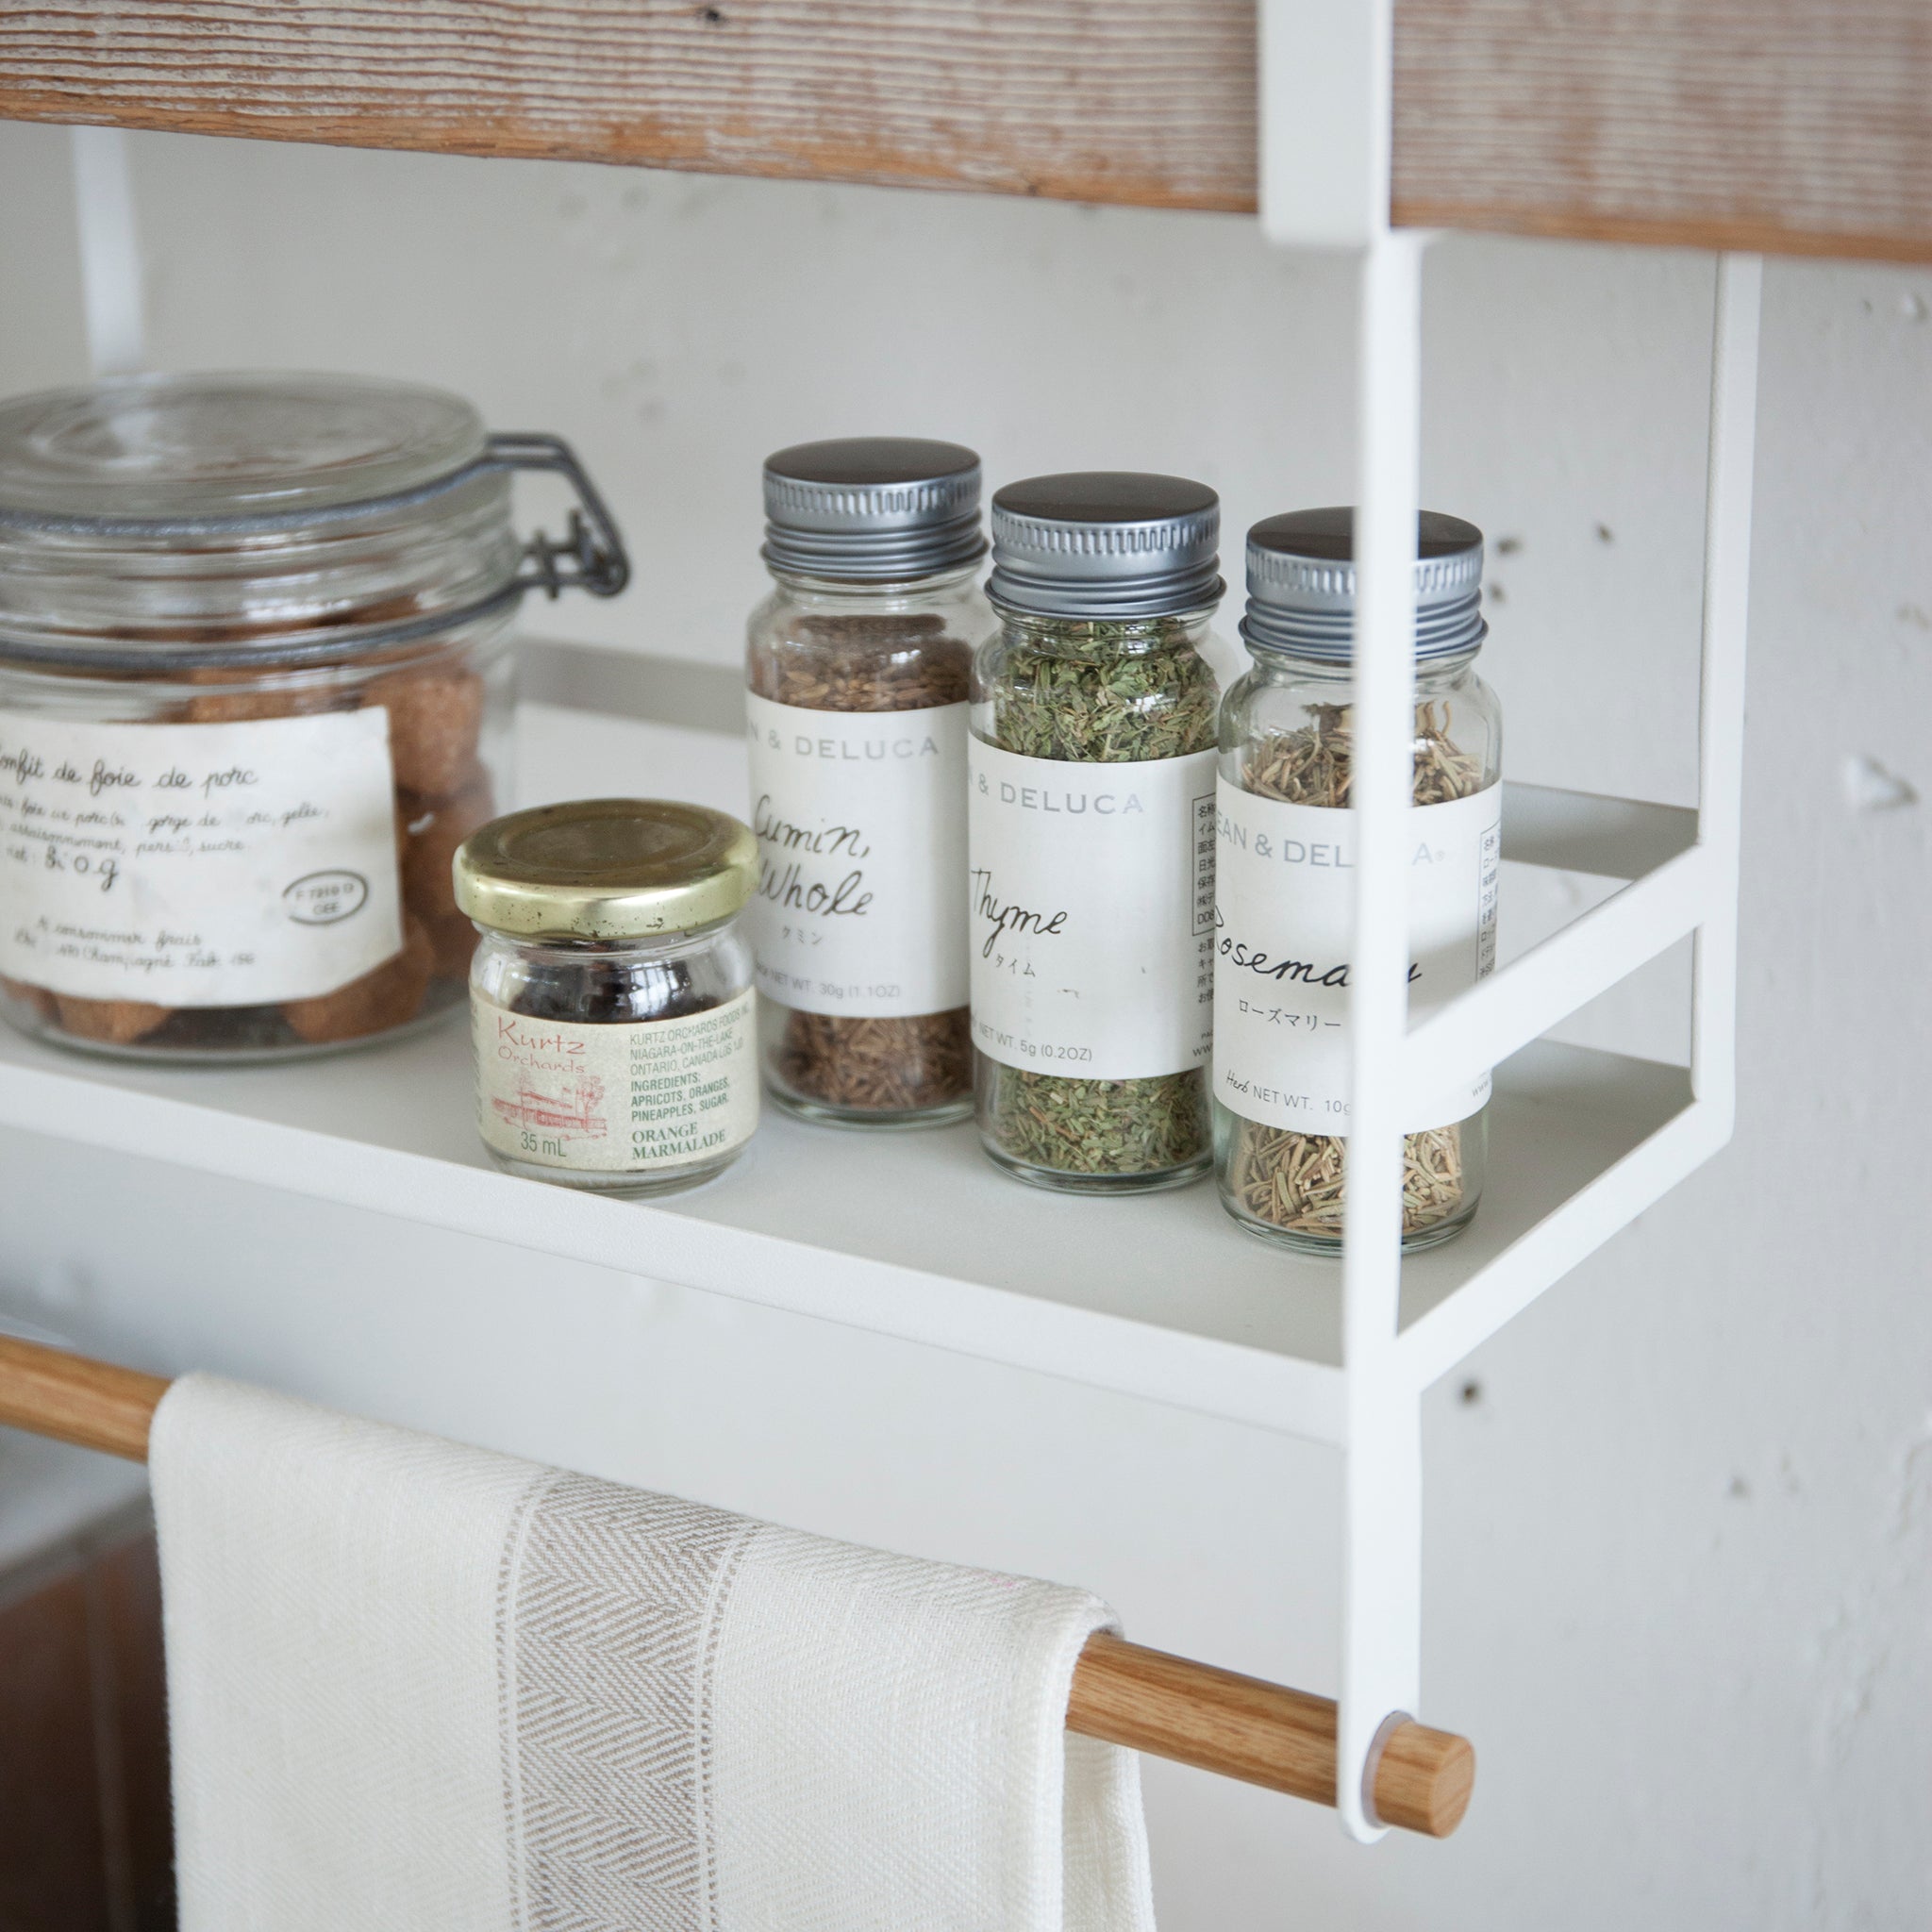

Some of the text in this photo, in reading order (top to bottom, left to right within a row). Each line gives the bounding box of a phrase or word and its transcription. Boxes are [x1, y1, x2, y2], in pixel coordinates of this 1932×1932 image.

[796, 736, 939, 759] DELUCA
[52, 763, 81, 783] de
[89, 758, 141, 796] foie
[152, 767, 192, 789] de
[201, 766, 258, 798] porc
[1001, 782, 1144, 815] DELUCA
[756, 793, 870, 858] Cumin,
[1218, 810, 1432, 868] EAN & DELA
[759, 859, 874, 917] Whole
[971, 868, 1068, 958] Thyme
[1239, 999, 1341, 1032] ローズマリー
[498, 1016, 586, 1055] Kurtz
[630, 1031, 665, 1046] KURTZ
[667, 1019, 717, 1041] ORCHARDS
[1020, 1040, 1037, 1057] 5g
[498, 1045, 585, 1074] Orchards
[682, 1049, 718, 1069] CANADA
[1226, 1070, 1248, 1093] Herb
[1253, 1086, 1279, 1104] NET
[1284, 1093, 1313, 1111] WT.
[521, 1131, 567, 1158] 35 mL
[631, 1122, 698, 1144] ORANGE
[632, 1129, 725, 1160] MARMALADE
